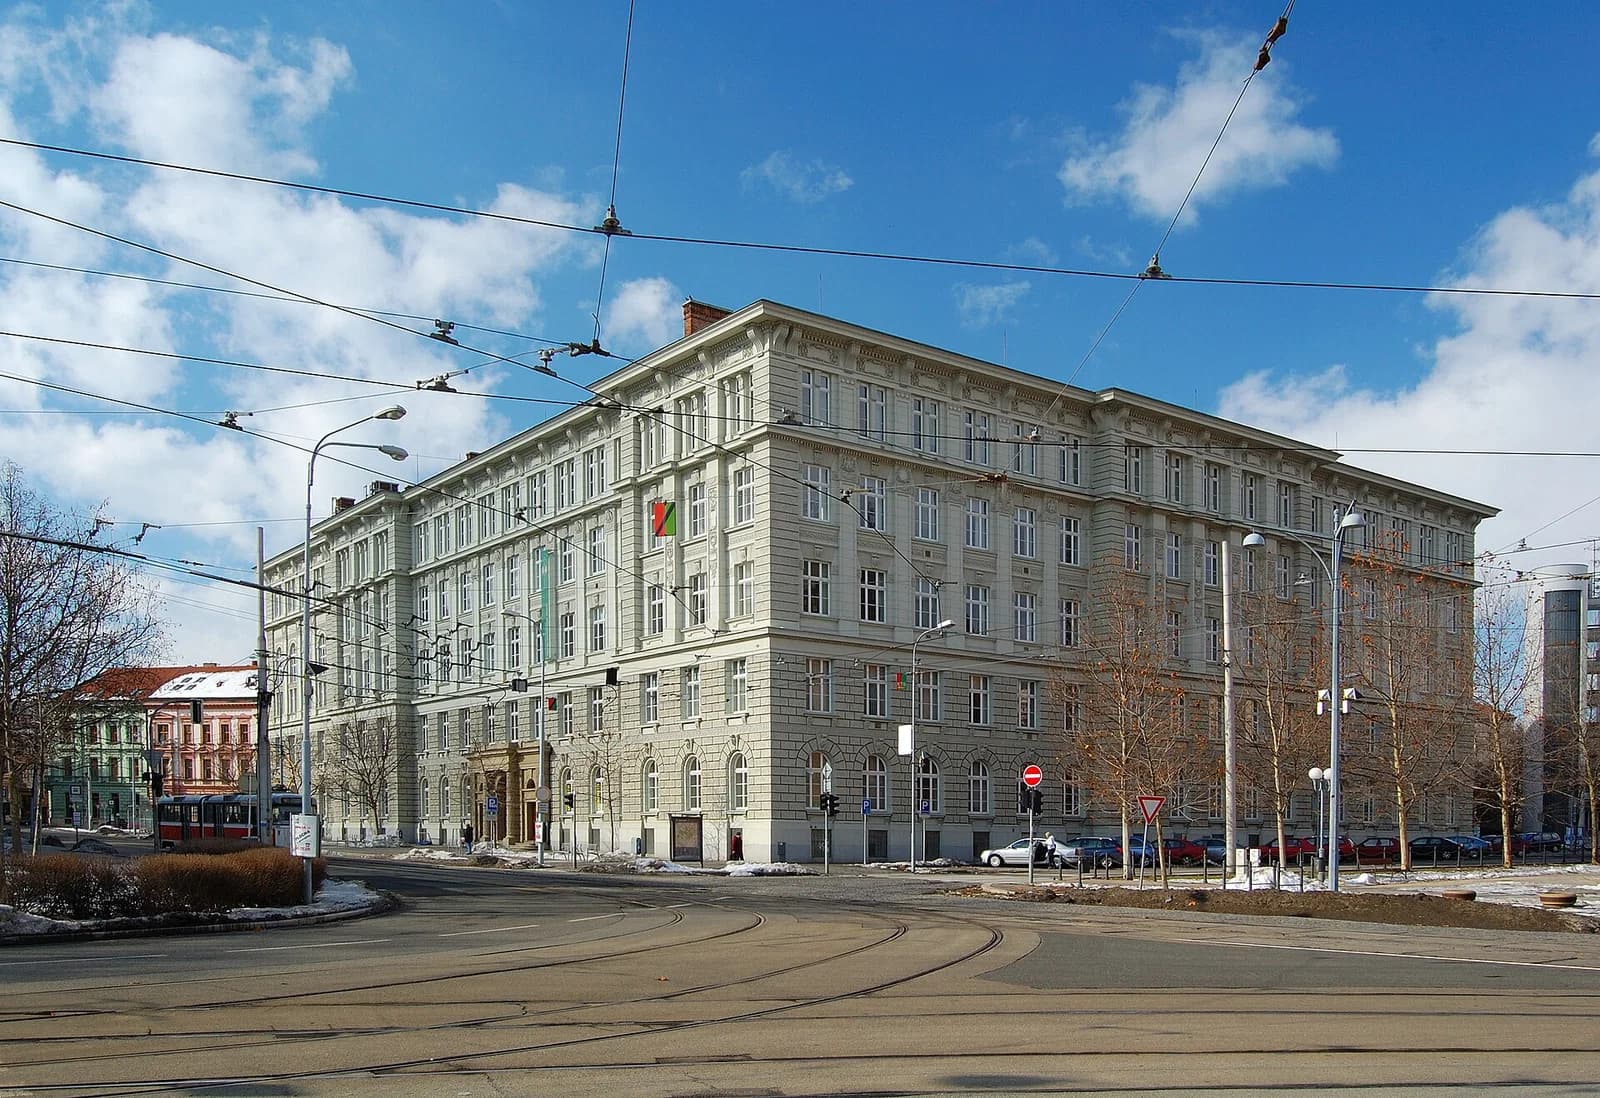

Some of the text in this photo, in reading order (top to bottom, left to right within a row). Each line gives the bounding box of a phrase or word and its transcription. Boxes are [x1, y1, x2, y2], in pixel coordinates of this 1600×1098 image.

[489, 798, 496, 808] P
[864, 801, 869, 810] P
[922, 801, 928, 810] P
